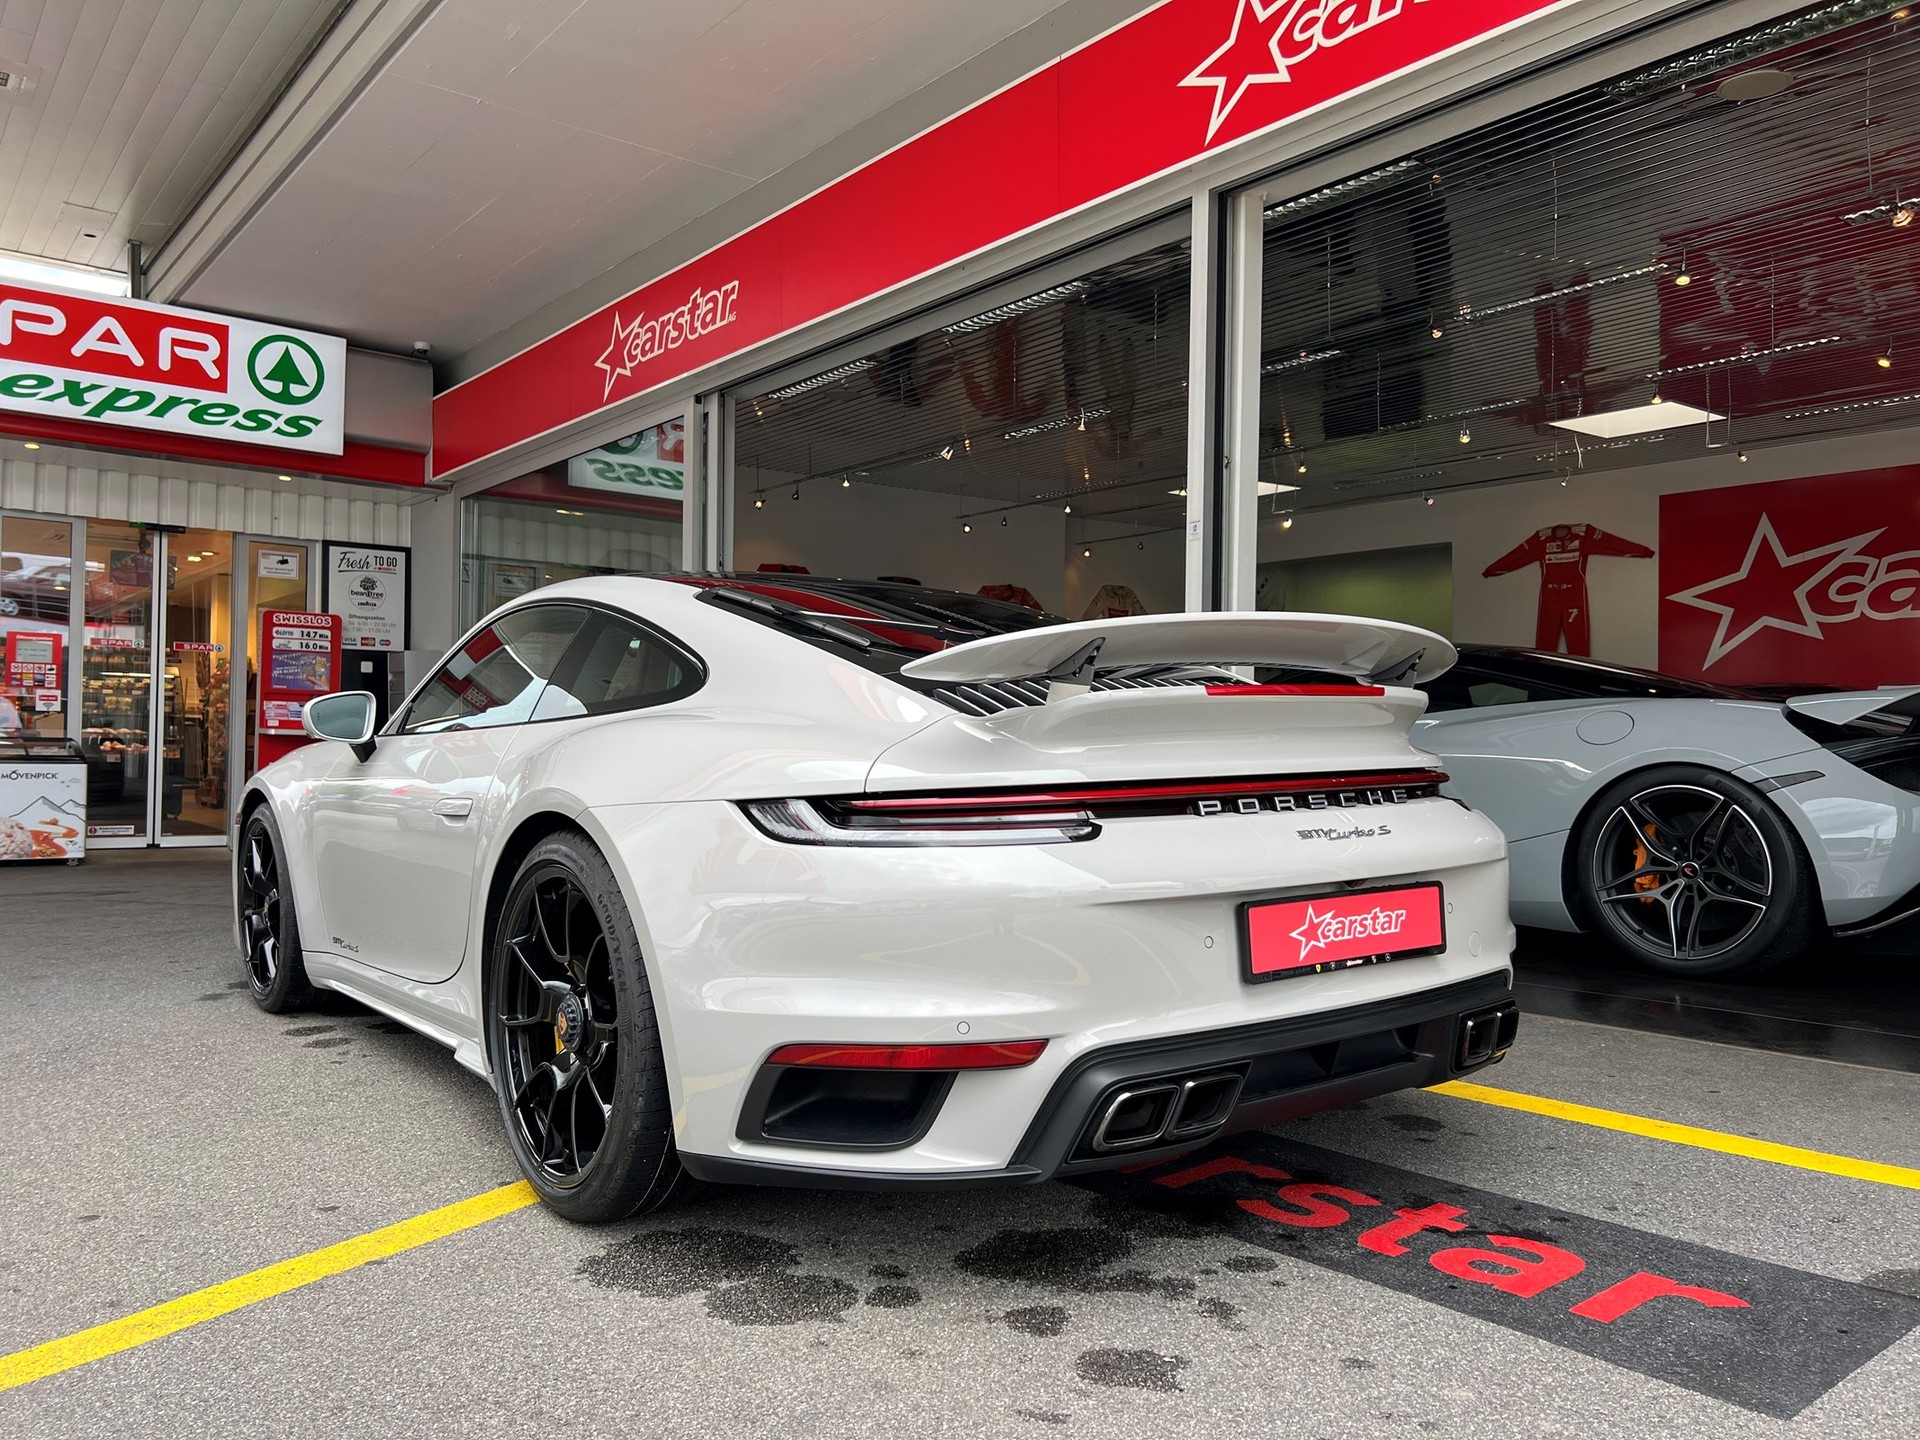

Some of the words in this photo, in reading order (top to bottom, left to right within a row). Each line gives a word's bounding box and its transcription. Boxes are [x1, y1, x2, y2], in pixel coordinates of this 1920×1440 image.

[624, 280, 739, 368] carstar
[727, 311, 737, 323] AG
[0, 373, 323, 438] express
[338, 551, 371, 569] Fresh
[374, 556, 384, 566] TO
[386, 557, 397, 567] GO
[274, 614, 331, 626] SWISSLOS
[1568, 608, 1578, 622] 7
[1198, 789, 1408, 816] PORSCHE
[1377, 825, 1391, 836] S
[1319, 906, 1406, 944] carstar
